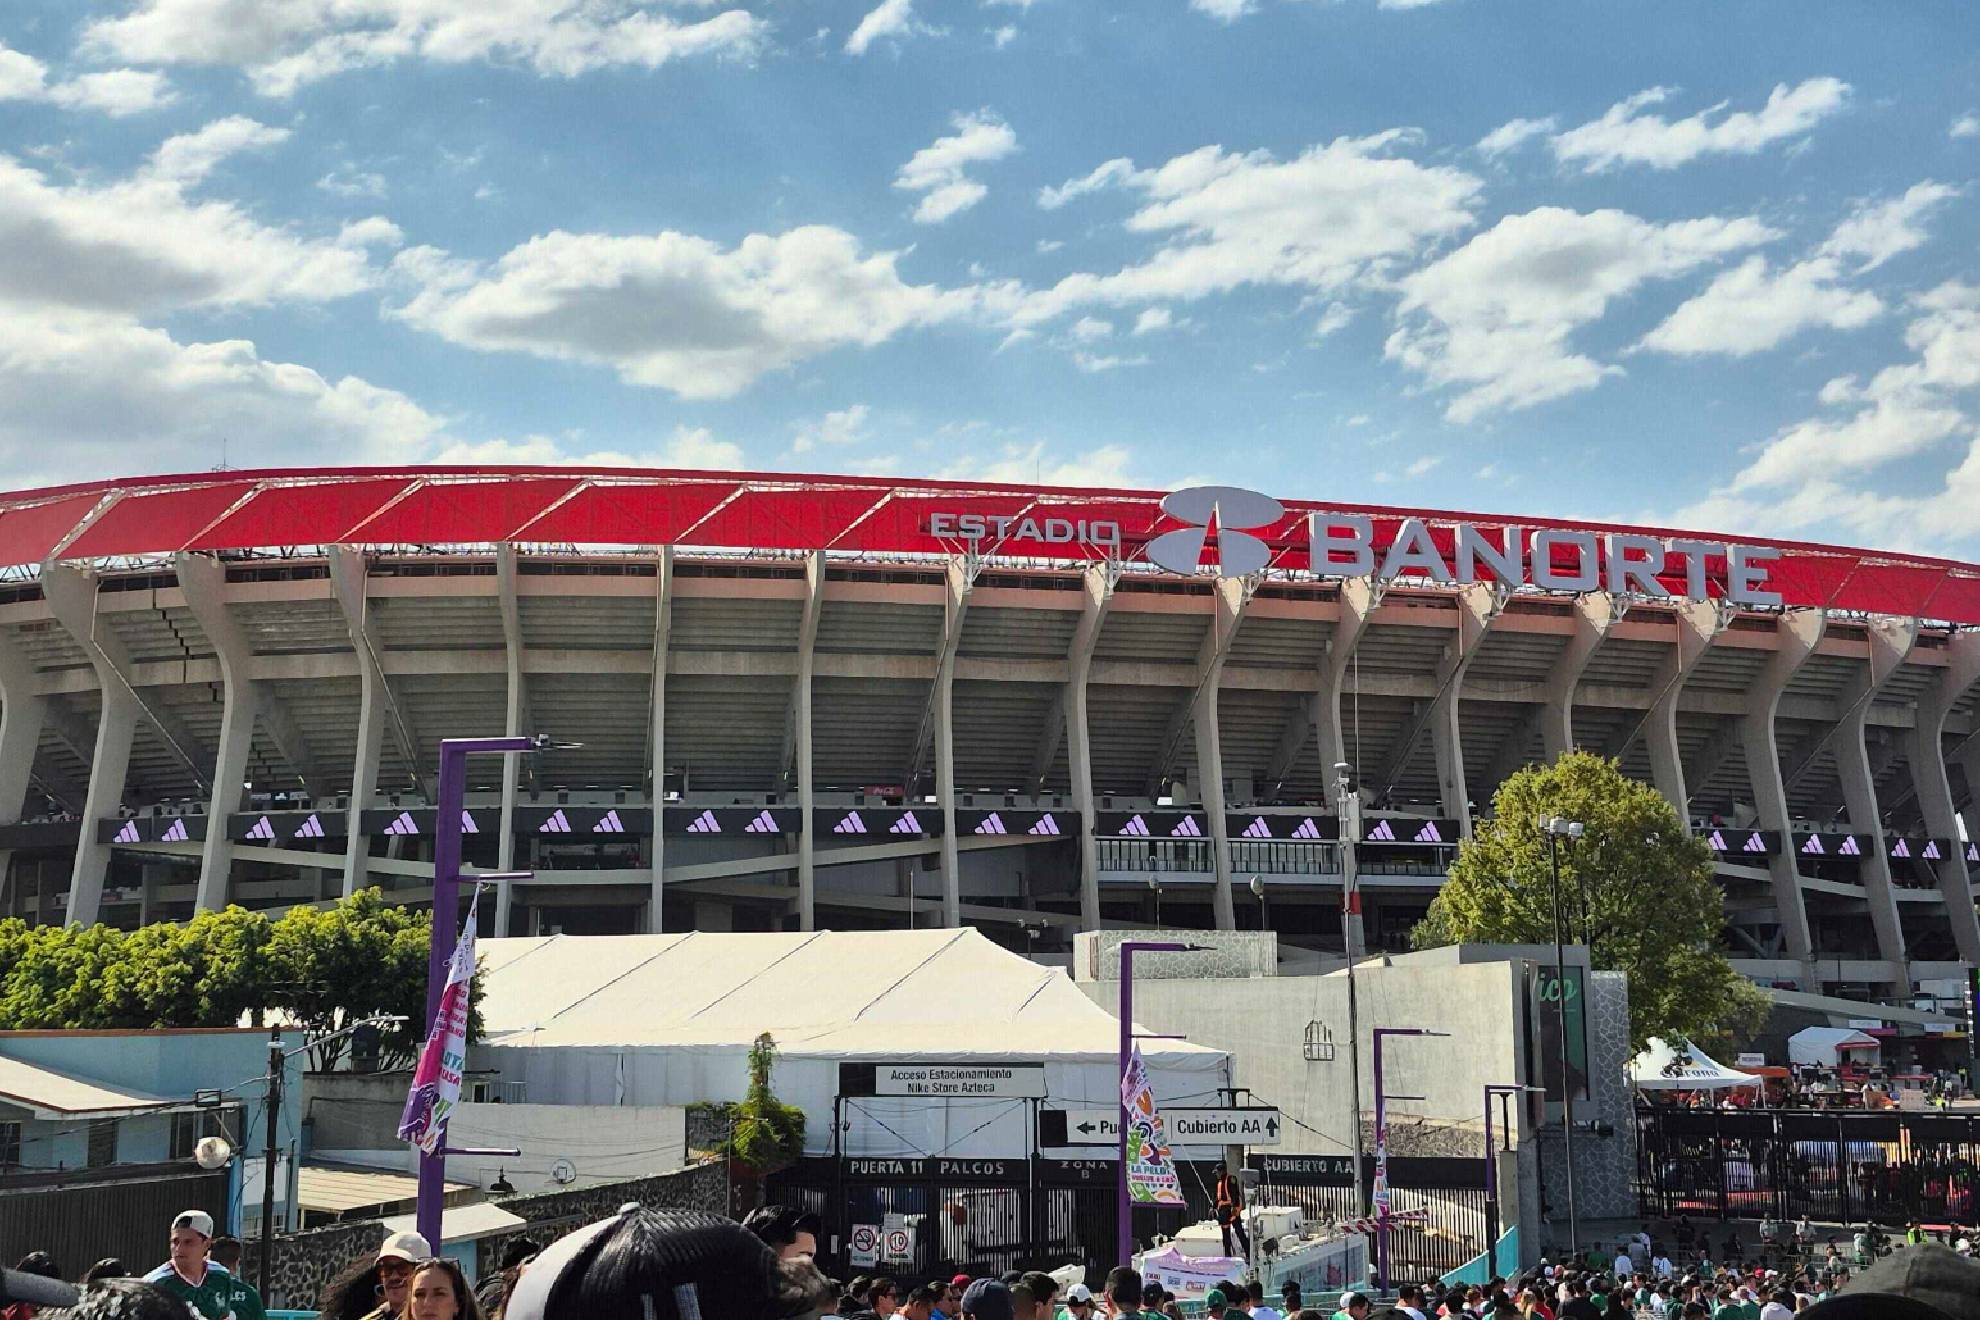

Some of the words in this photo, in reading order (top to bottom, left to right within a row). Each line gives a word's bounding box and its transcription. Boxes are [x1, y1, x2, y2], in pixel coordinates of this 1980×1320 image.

[930, 513, 1119, 546] ESTADIO
[1308, 512, 1782, 604] BANORTE
[891, 1070, 927, 1080] Acceso
[929, 1068, 1012, 1080] Estacionamiento
[907, 1082, 929, 1093] Nike
[931, 1082, 959, 1093] Store
[961, 1082, 995, 1093] Azteca
[1177, 1119, 1237, 1134] Cubierto
[1241, 1119, 1261, 1134] AA
[851, 1160, 904, 1175] PUERTA
[911, 1160, 923, 1175] 11
[940, 1161, 1005, 1175] PALCOS
[1060, 1160, 1109, 1170] ZONA
[1263, 1159, 1328, 1174] CUBIERTO
[1334, 1160, 1354, 1174] AA
[893, 1234, 905, 1246] 10
